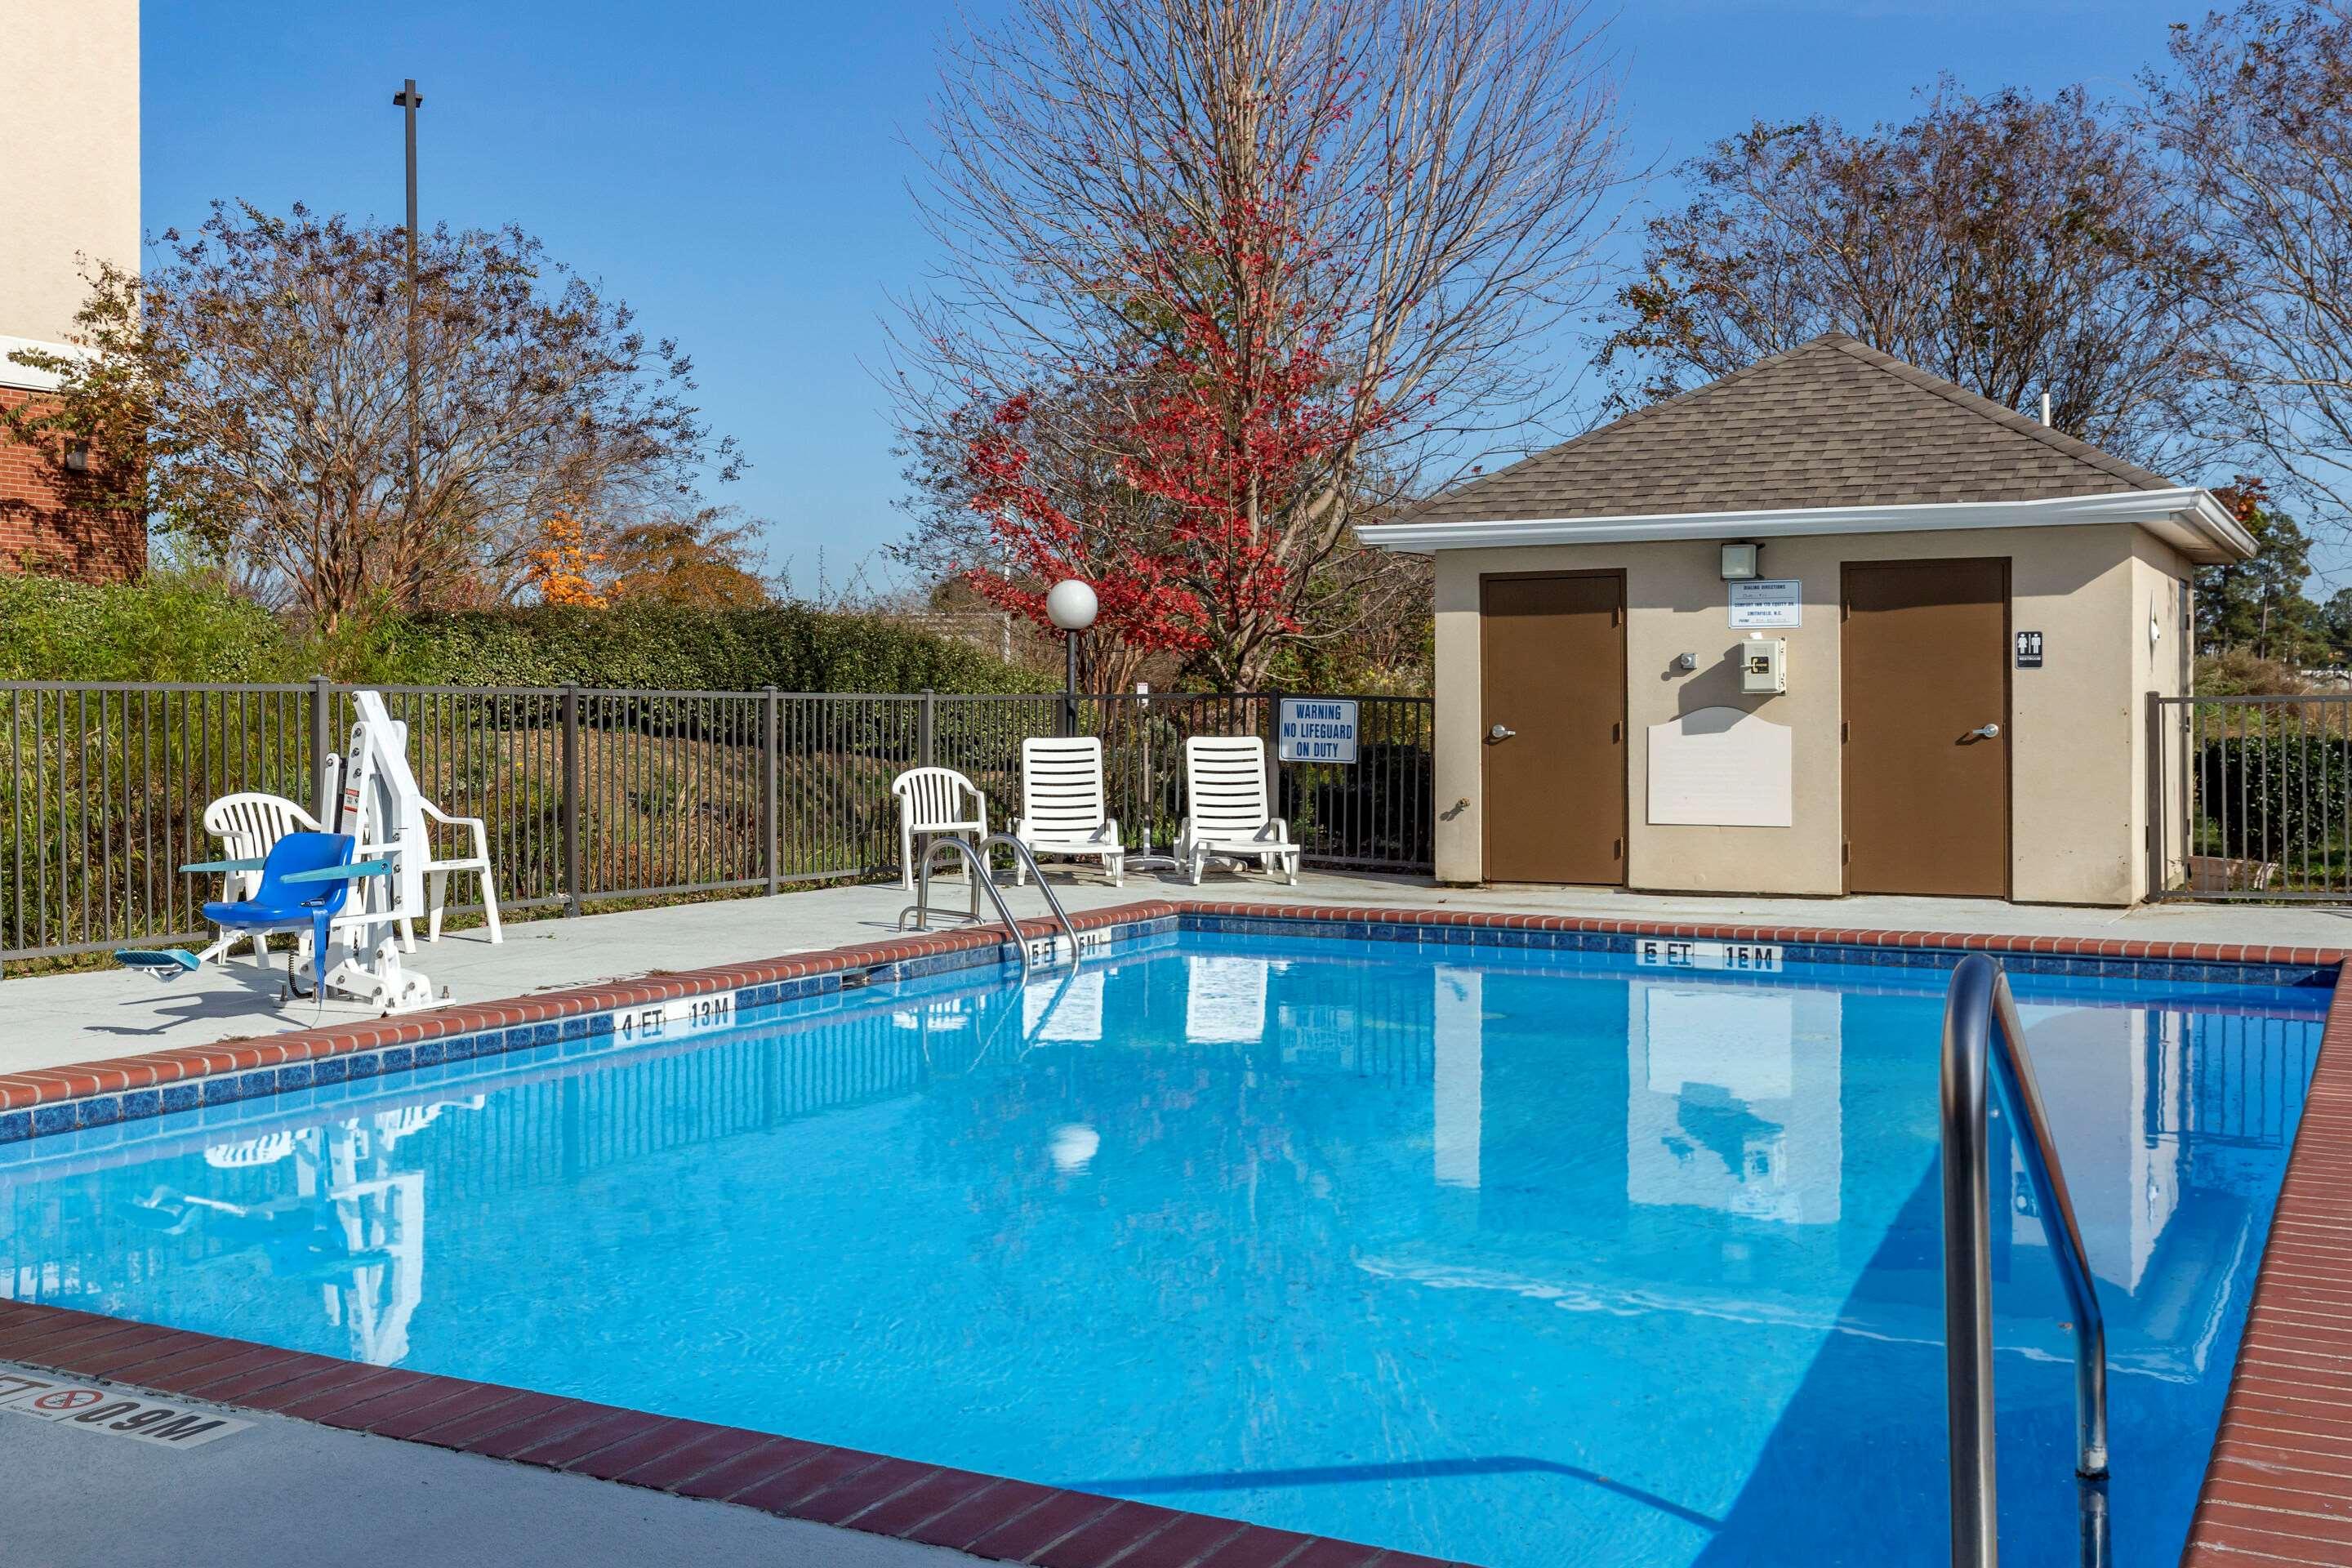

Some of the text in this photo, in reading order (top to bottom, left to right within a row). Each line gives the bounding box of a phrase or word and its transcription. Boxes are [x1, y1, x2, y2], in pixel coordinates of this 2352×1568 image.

[1296, 704, 1341, 719] WARNING
[1284, 723, 1352, 739] NO LIFEGUARD
[1297, 742, 1339, 757] ON DUTY
